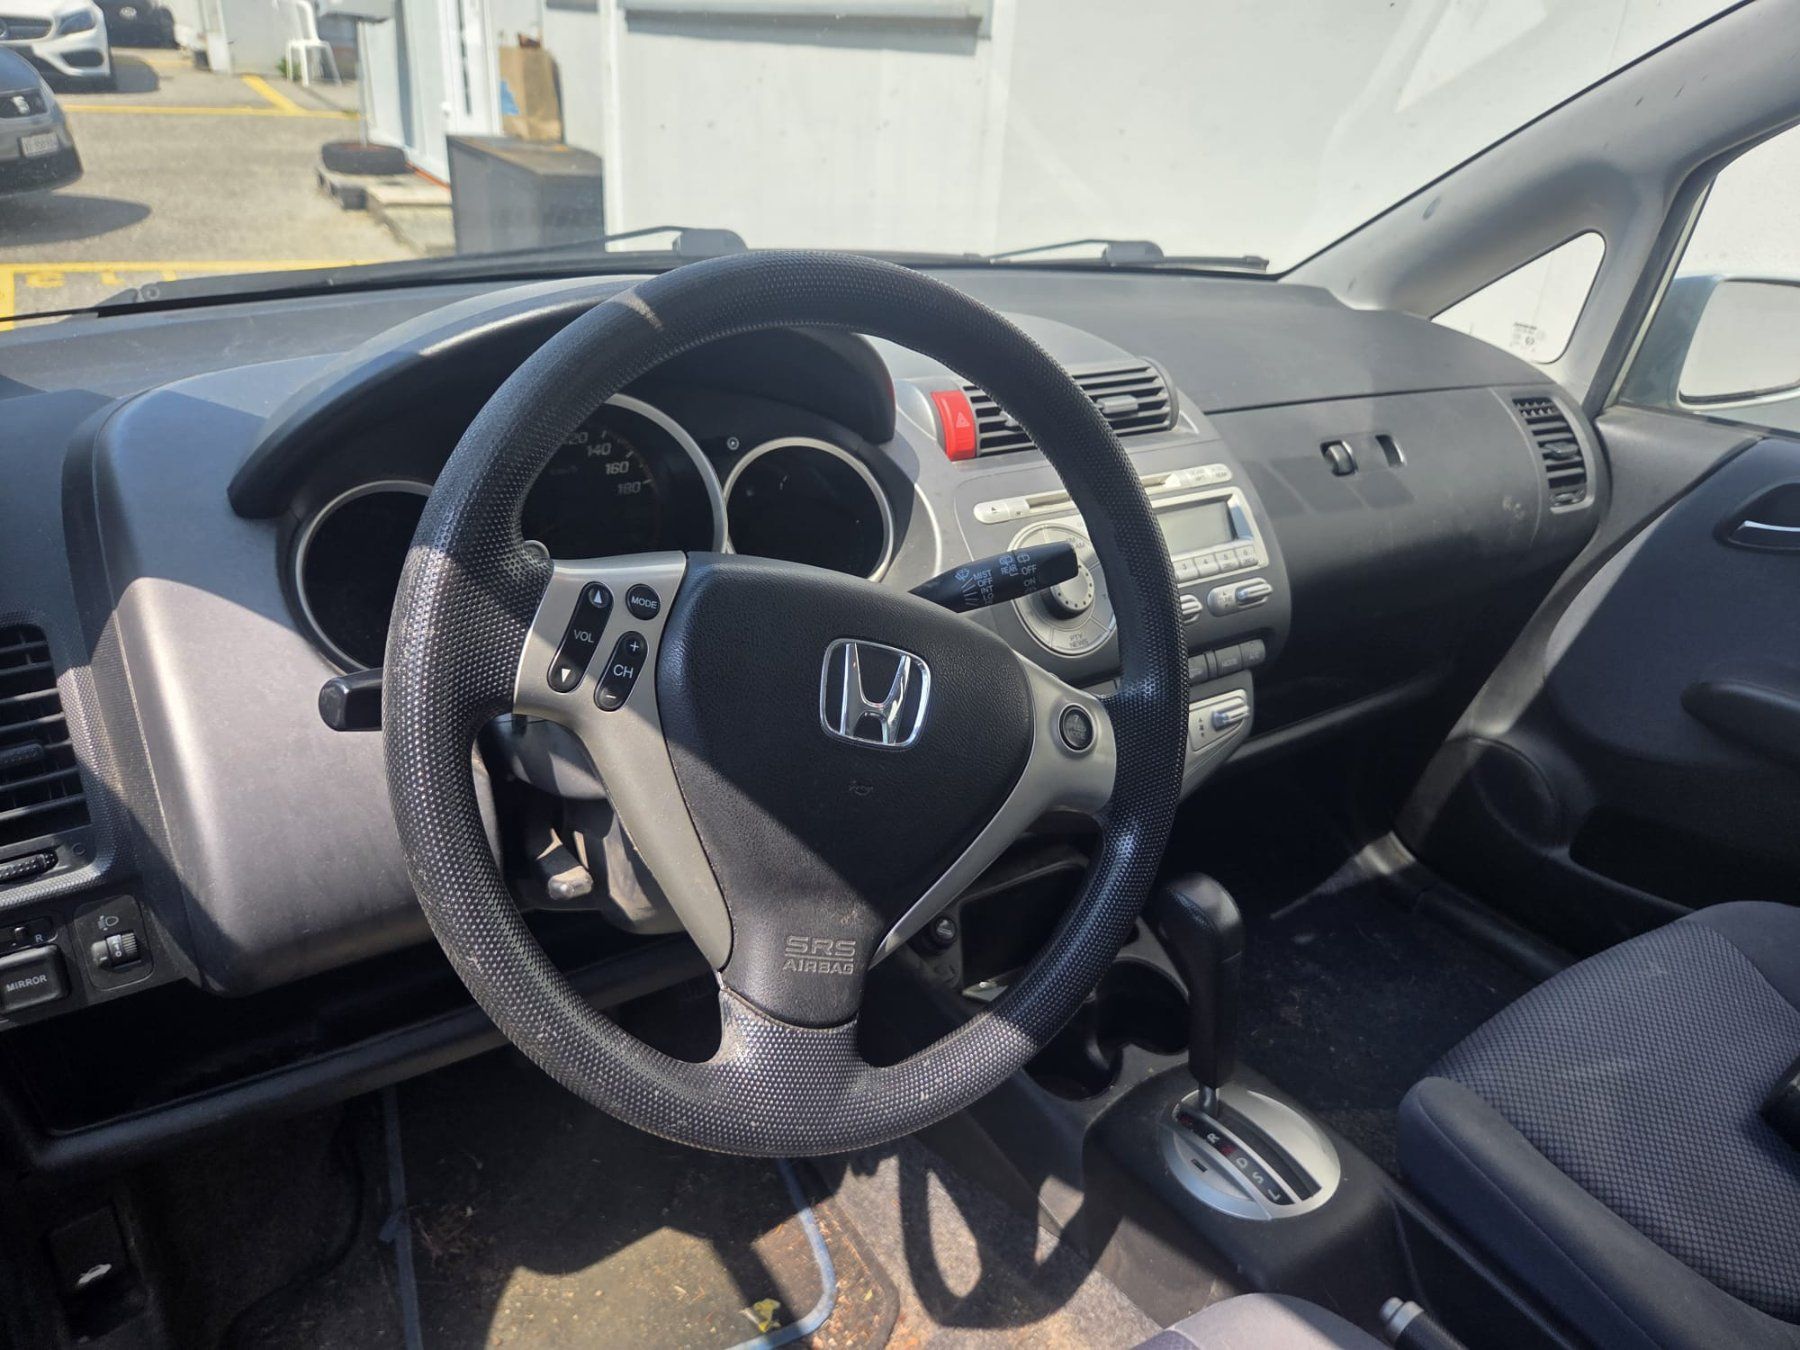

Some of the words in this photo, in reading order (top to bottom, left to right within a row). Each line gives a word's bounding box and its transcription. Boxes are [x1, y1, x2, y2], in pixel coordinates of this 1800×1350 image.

[587, 442, 612, 457] 140
[605, 461, 630, 475] 160
[617, 481, 642, 495] 180
[973, 570, 992, 581] MIST
[1021, 564, 1037, 576] OFF
[978, 577, 993, 586] OFF
[1024, 577, 1036, 586] ON
[631, 596, 658, 610] MODE
[573, 629, 595, 644] VOL
[613, 664, 634, 679] CH
[35, 933, 43, 943] R
[785, 935, 856, 956] SRS
[783, 958, 854, 974] AIRBAG
[6, 974, 47, 992] MIRROR
[1207, 1133, 1220, 1144] R
[1236, 1157, 1248, 1168] D
[1252, 1172, 1264, 1184] S
[1268, 1189, 1281, 1200] L
